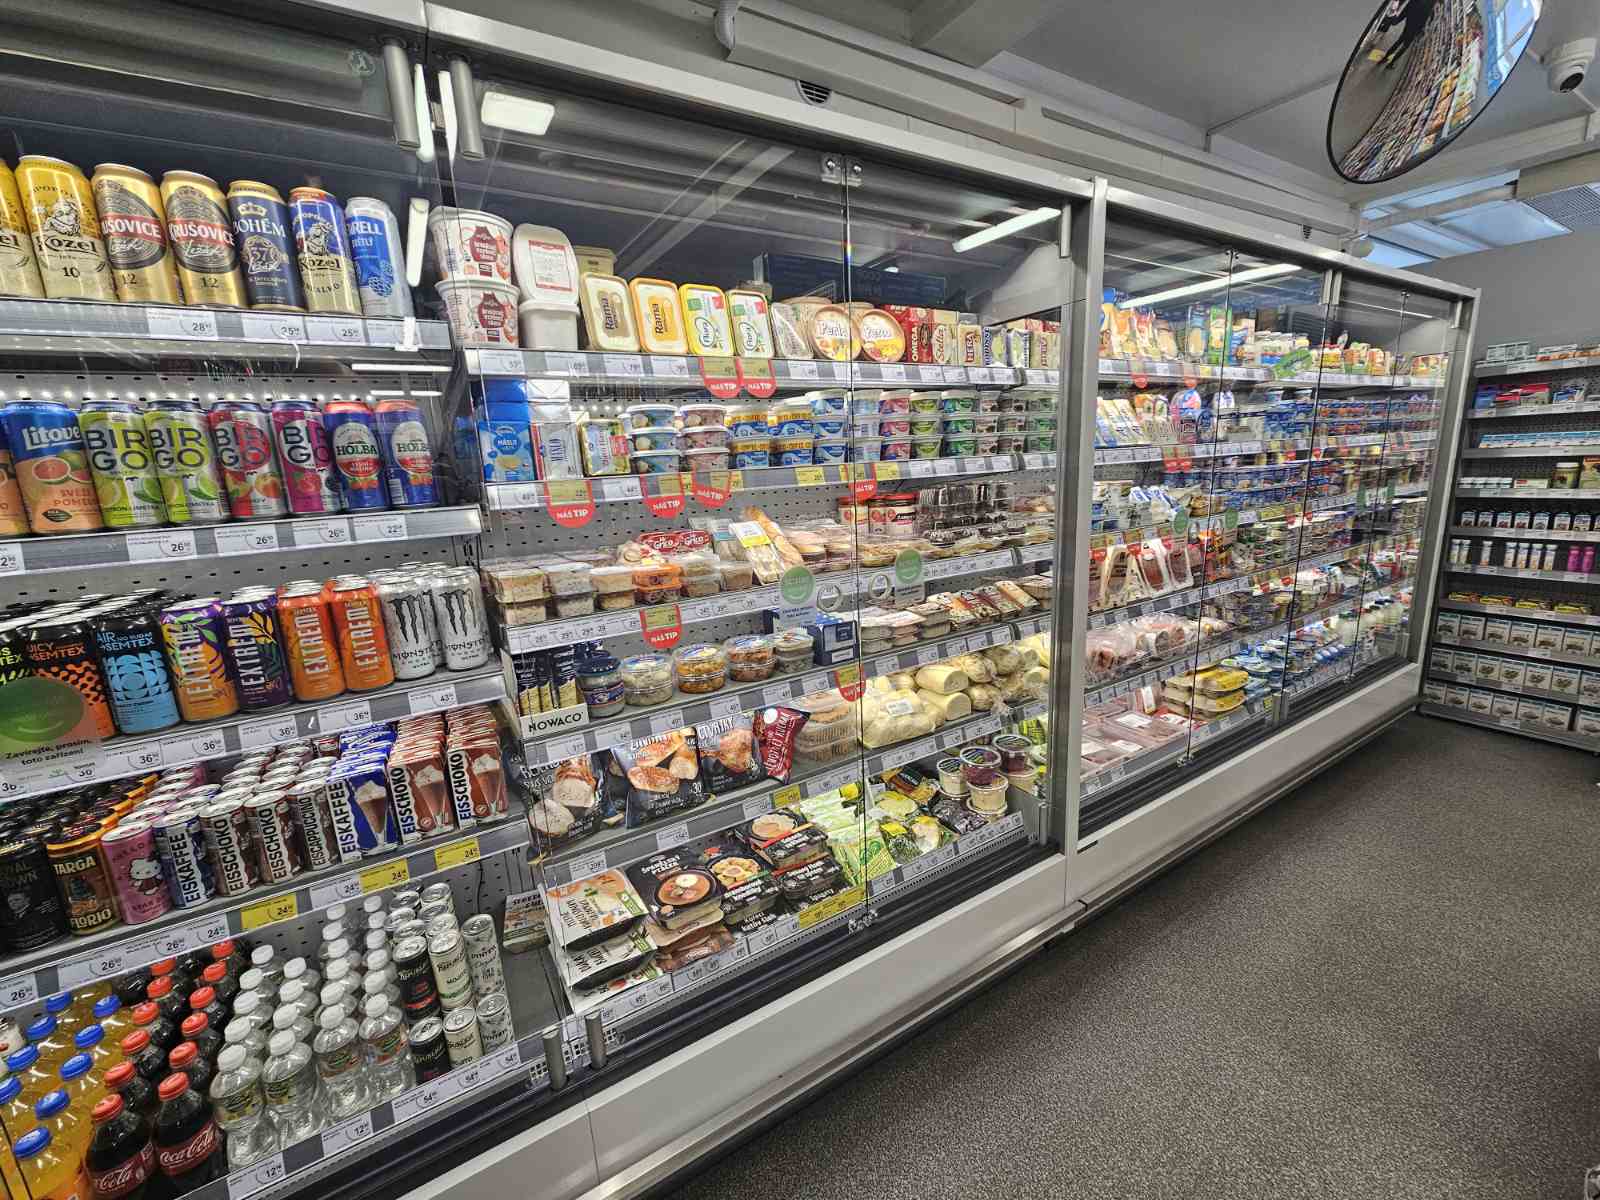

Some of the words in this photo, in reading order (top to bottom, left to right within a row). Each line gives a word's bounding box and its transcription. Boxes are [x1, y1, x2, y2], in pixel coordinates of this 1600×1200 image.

[101, 217, 162, 238] UŠOVICE
[350, 220, 384, 236] RELL
[35, 235, 97, 252] Kozel
[62, 266, 80, 278] 10
[300, 254, 341, 271] Kozel
[201, 276, 218, 288] 12
[21, 425, 81, 450] Litove
[84, 429, 149, 450] BIR
[149, 427, 204, 448] BIR
[91, 450, 149, 471] GO
[154, 448, 205, 469] GO
[336, 445, 378, 456] HOLBA
[103, 638, 154, 651] SEMTEX
[0, 654, 22, 666] TEX
[528, 713, 582, 732] NOWACO
[450, 752, 472, 822] EISSCHOKO
[390, 768, 416, 834] EISSCHOKO
[328, 780, 356, 855] EISKAFFEE
[257, 808, 288, 879] EISSCHOKO
[214, 817, 245, 892] EISSCHOKO
[53, 856, 96, 876] TARGA
[169, 832, 201, 904] EISKAFFEE
[70, 908, 112, 929] FLORIO
